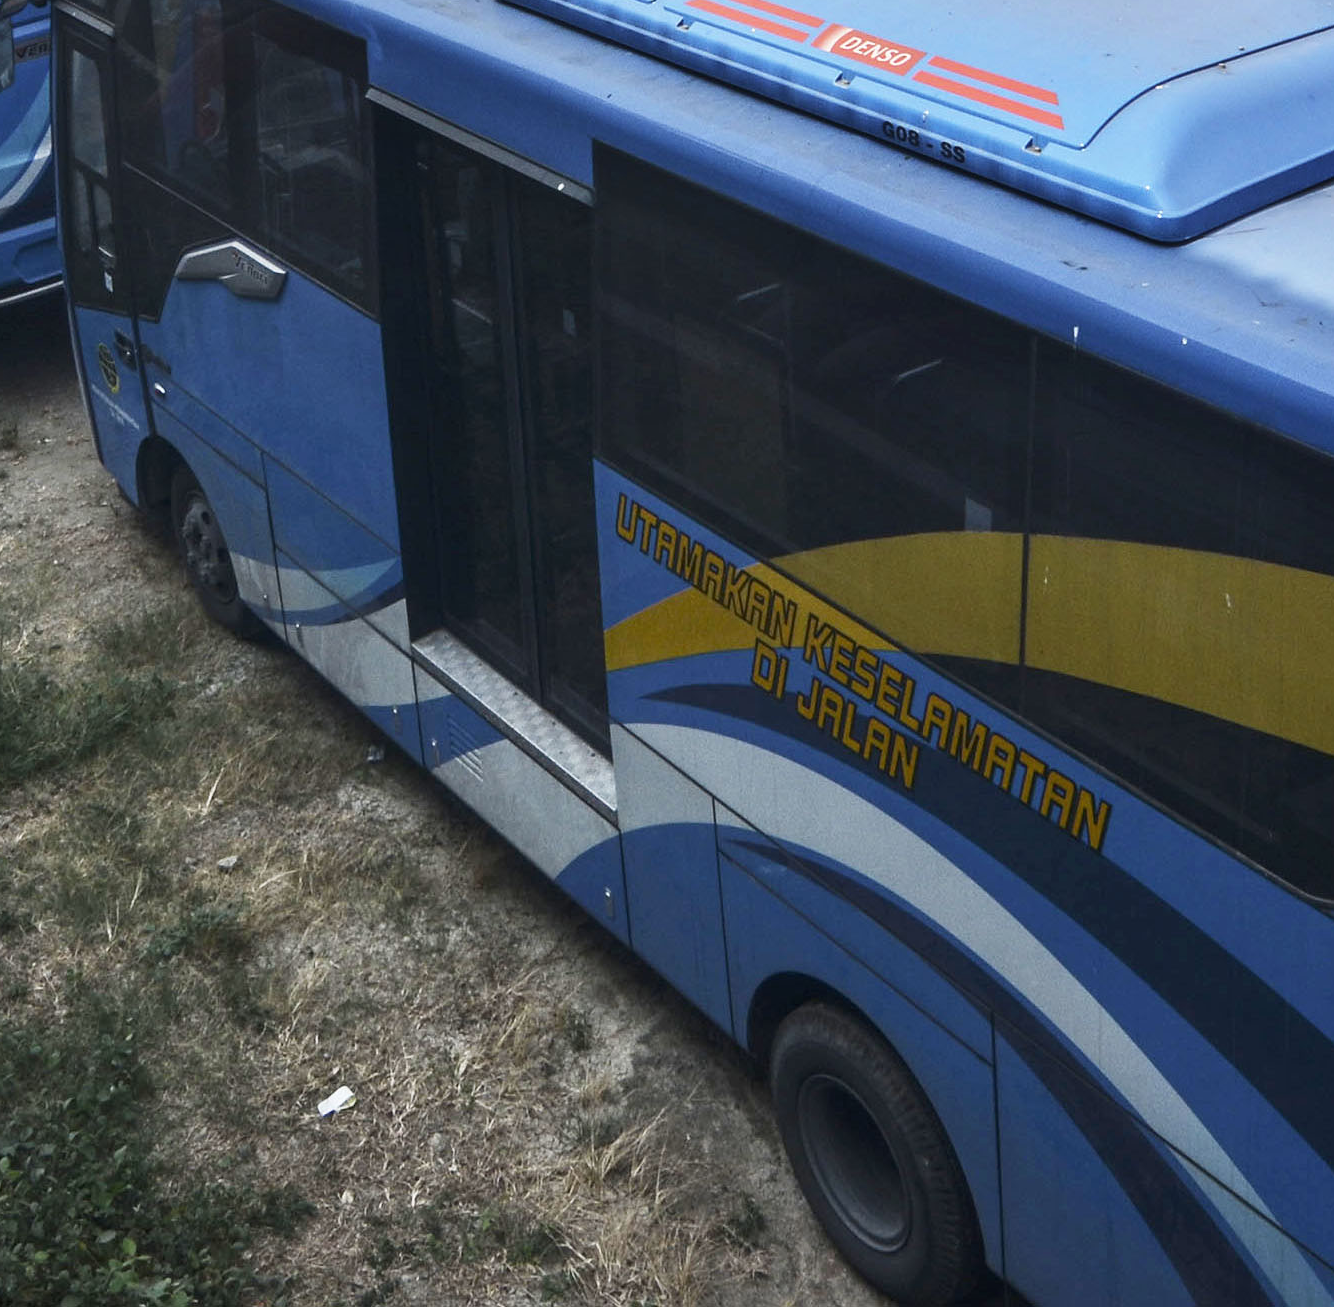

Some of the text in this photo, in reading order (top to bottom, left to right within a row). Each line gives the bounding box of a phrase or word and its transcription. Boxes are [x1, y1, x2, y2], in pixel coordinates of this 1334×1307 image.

[839, 36, 912, 66] DENSO
[882, 120, 920, 149] G08
[940, 141, 966, 164] SS
[616, 494, 1113, 853] UTAMAKAN KESELAMATAN
[751, 638, 921, 790] DI JALAN
